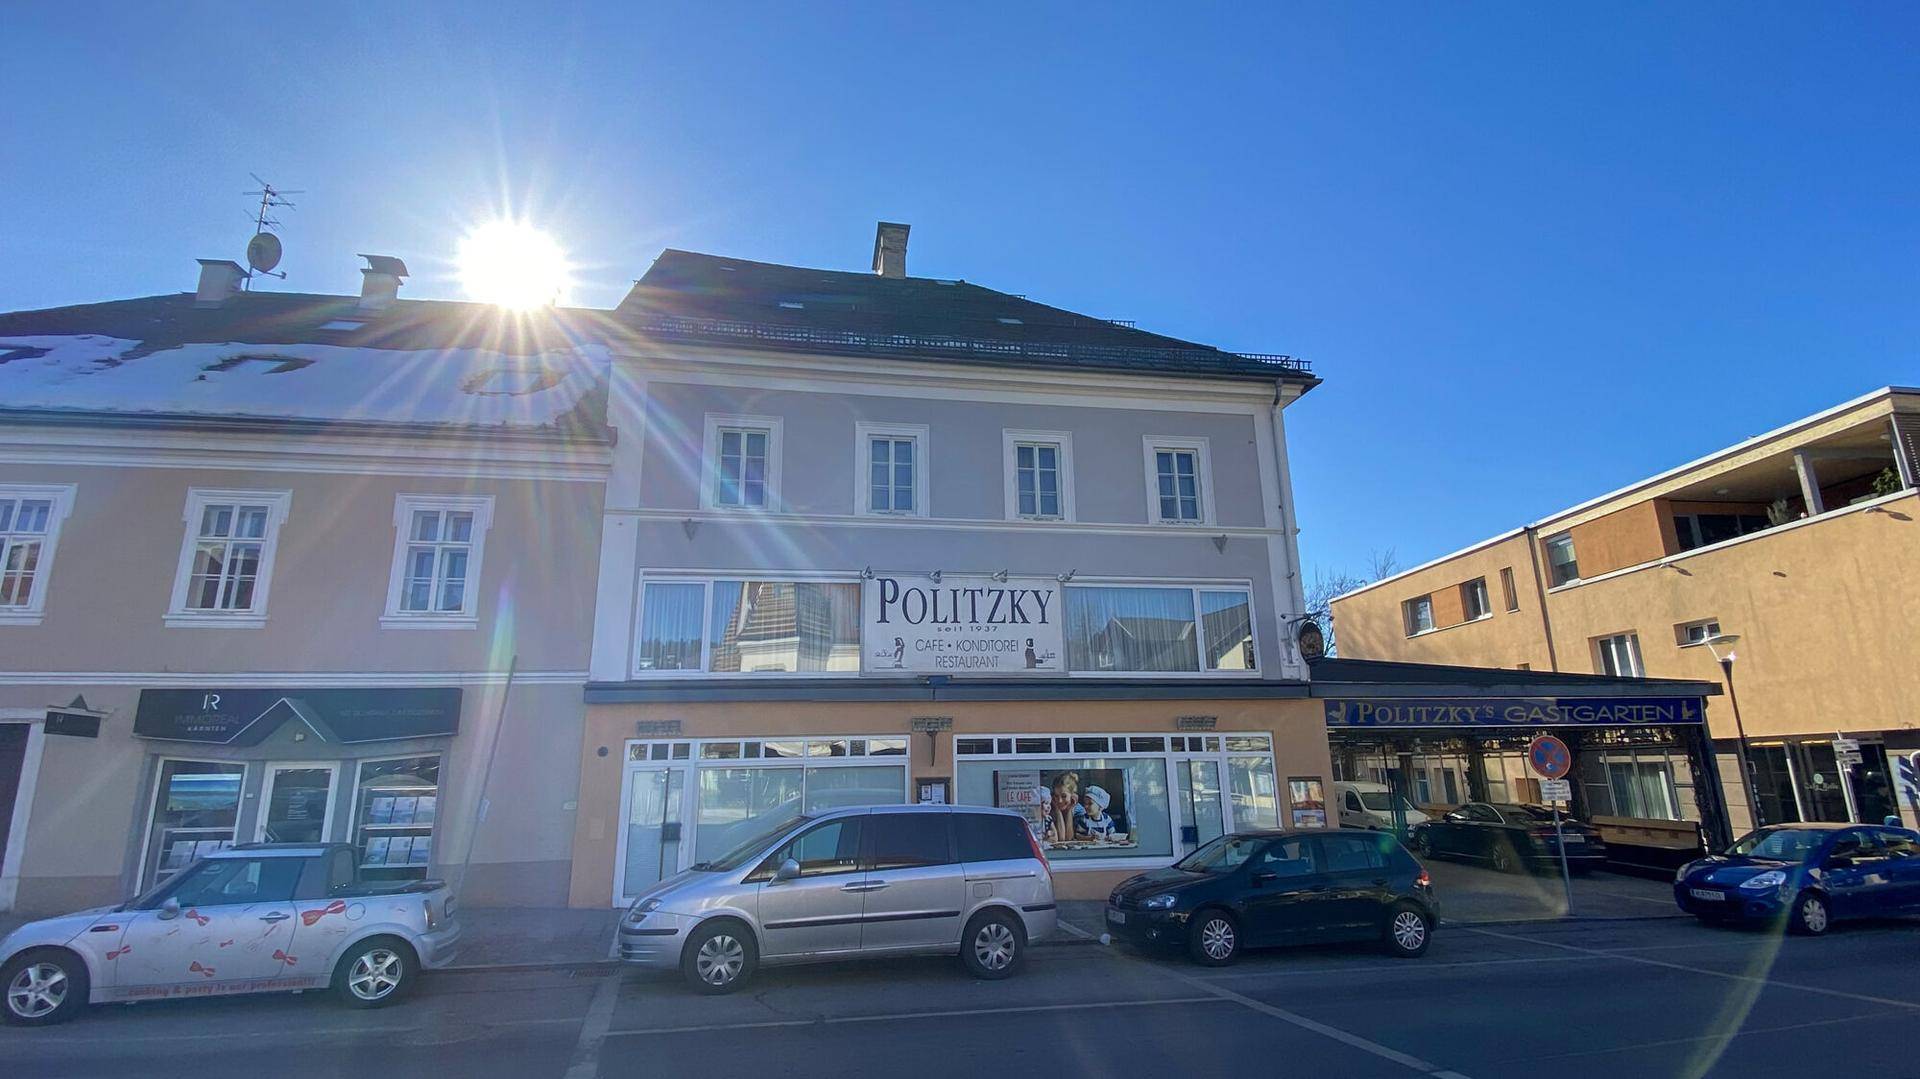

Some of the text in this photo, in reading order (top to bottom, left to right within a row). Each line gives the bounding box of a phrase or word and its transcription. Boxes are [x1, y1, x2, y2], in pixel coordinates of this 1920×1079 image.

[876, 578, 1054, 624] POLITZKY
[970, 625, 998, 633] 1937
[915, 639, 1019, 652] CAFE KONDITOREI
[935, 655, 1000, 668] RESTAURANT
[1504, 705, 1674, 723] GASTGARTEN
